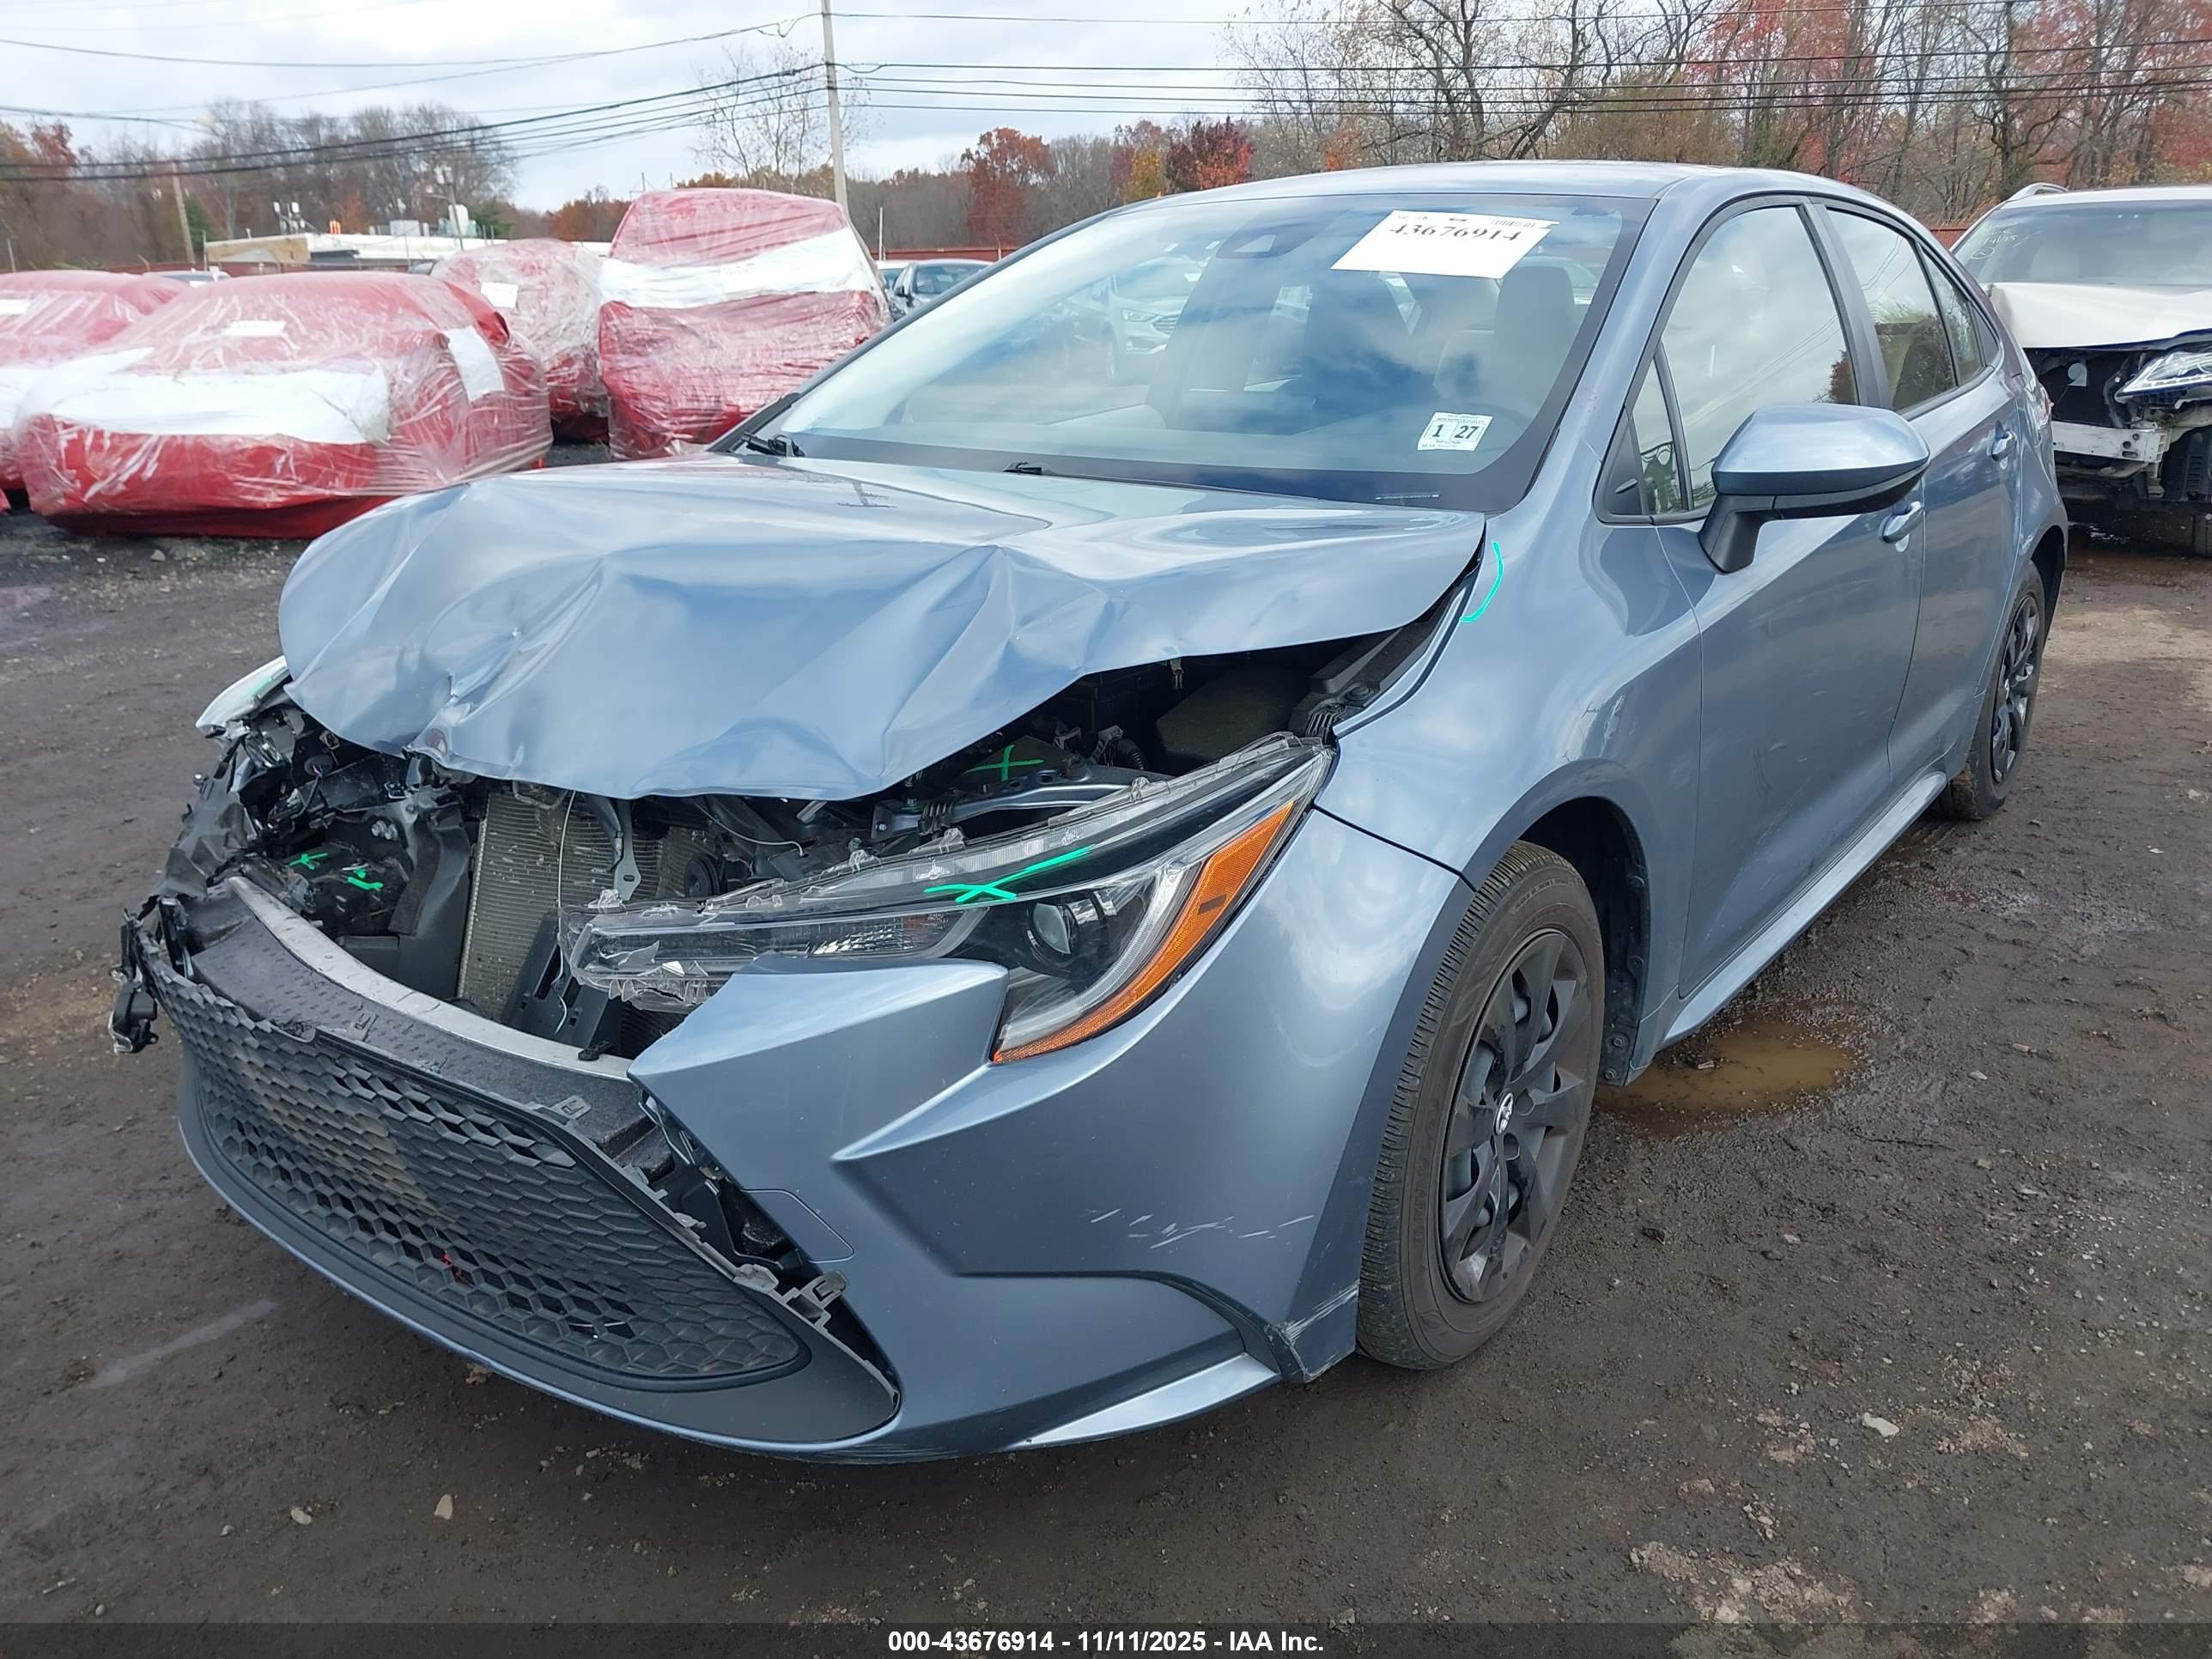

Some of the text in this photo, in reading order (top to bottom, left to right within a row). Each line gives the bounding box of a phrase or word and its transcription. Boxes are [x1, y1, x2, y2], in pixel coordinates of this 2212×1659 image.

[1389, 223, 1522, 240] 43676914
[1431, 423, 1480, 440] 1 27
